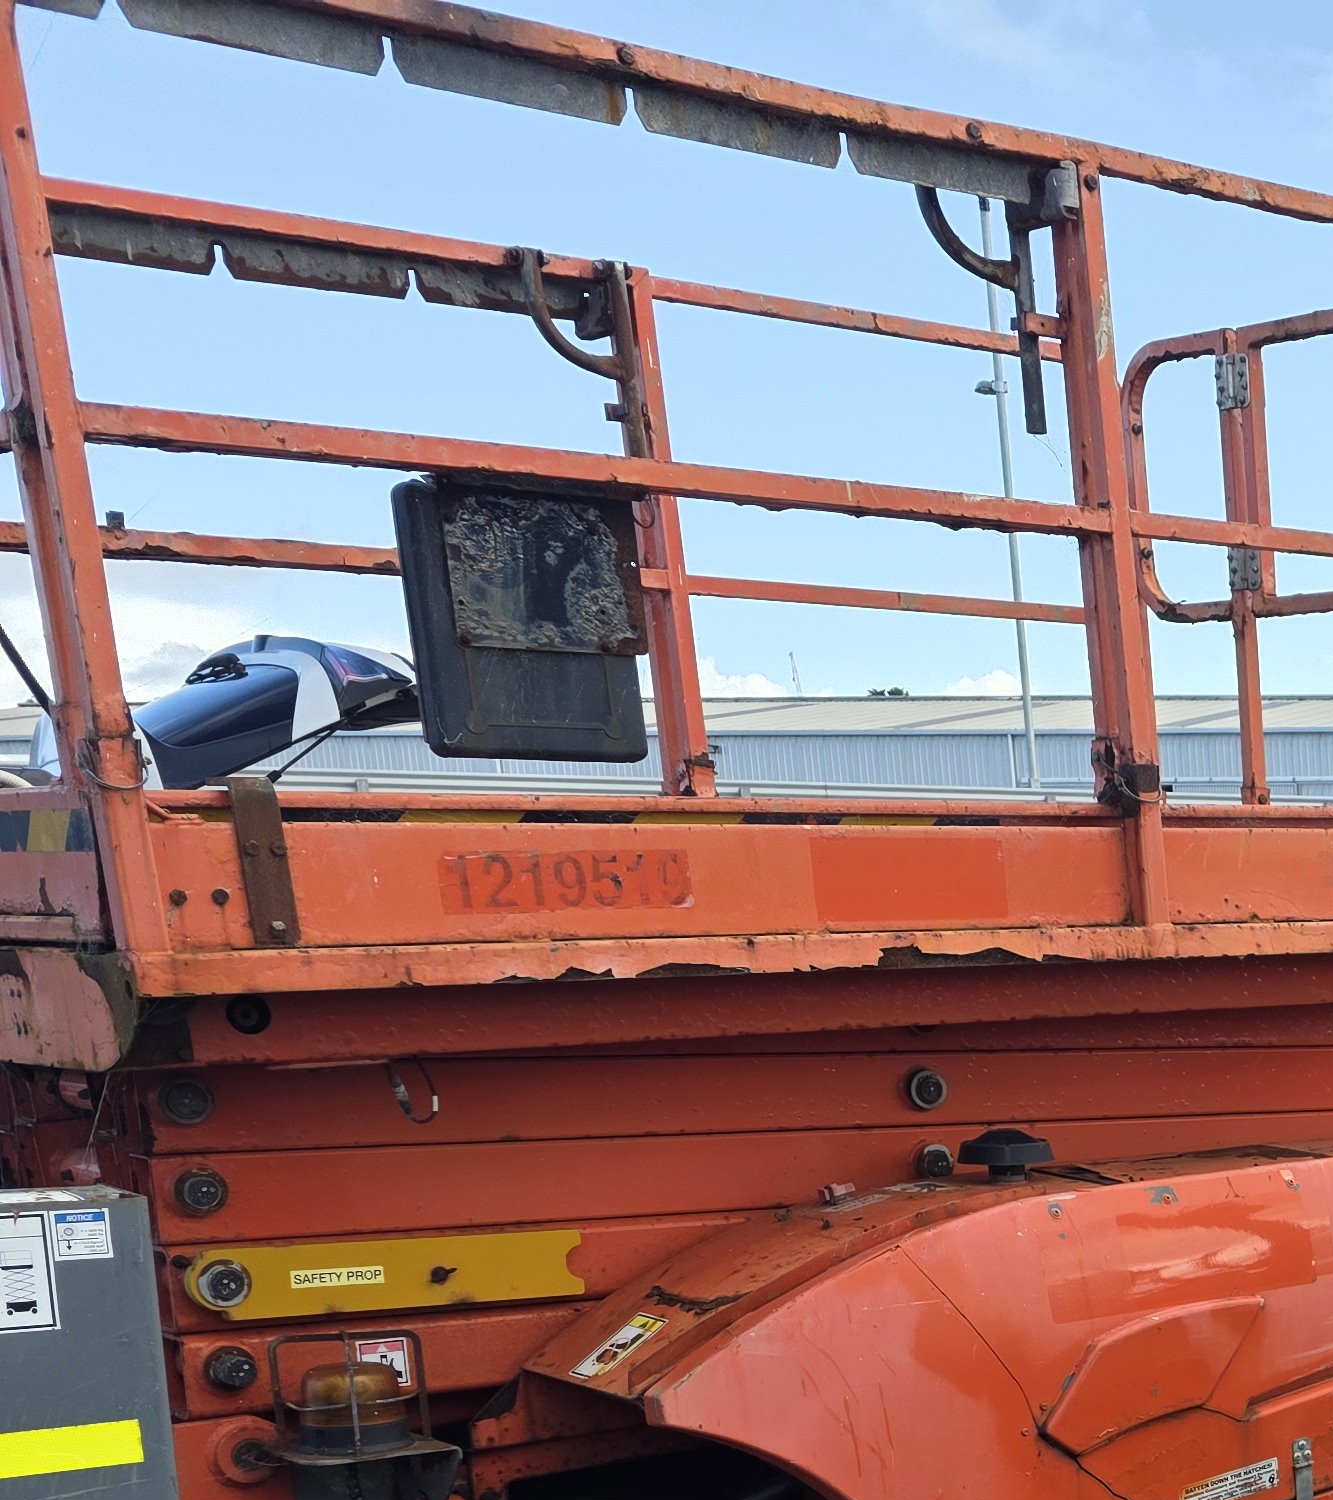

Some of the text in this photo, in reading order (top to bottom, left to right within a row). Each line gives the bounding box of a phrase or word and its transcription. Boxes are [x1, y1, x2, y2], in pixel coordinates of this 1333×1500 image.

[66, 1213, 94, 1222] NOTICE
[293, 1269, 382, 1285] SAFETY PROP
[1185, 1481, 1209, 1495] BATTEN
[1210, 1476, 1229, 1487] DOWN
[1230, 1472, 1242, 1480] THE
